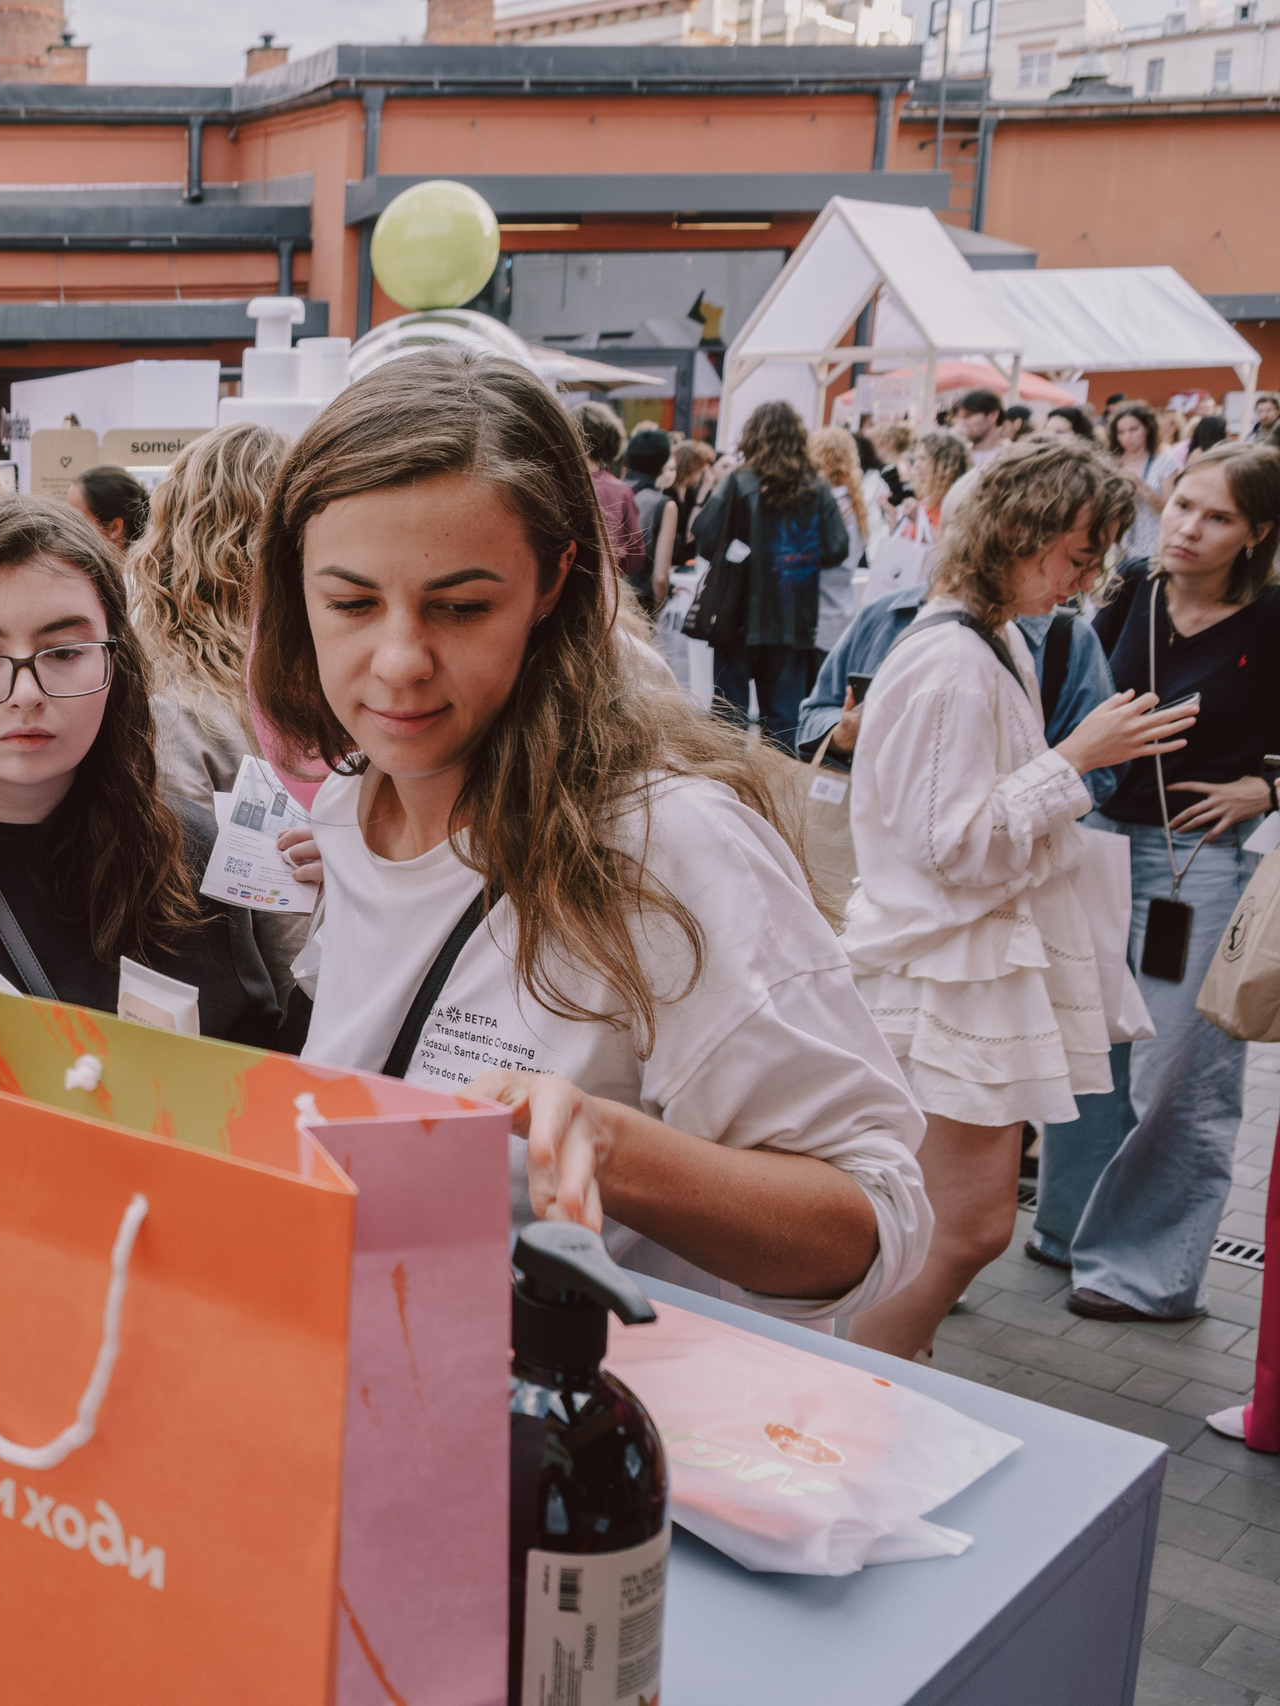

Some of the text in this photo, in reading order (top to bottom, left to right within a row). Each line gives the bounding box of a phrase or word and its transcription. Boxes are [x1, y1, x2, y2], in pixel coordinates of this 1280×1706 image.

[464, 1012, 498, 1028] ВЕТРА
[435, 1023, 535, 1059] Transatlantic Crossing
[454, 1045, 480, 1061] Santa
[500, 1058, 513, 1070] de
[441, 1069, 456, 1081] dos
[21, 1485, 166, 1592] ходи
